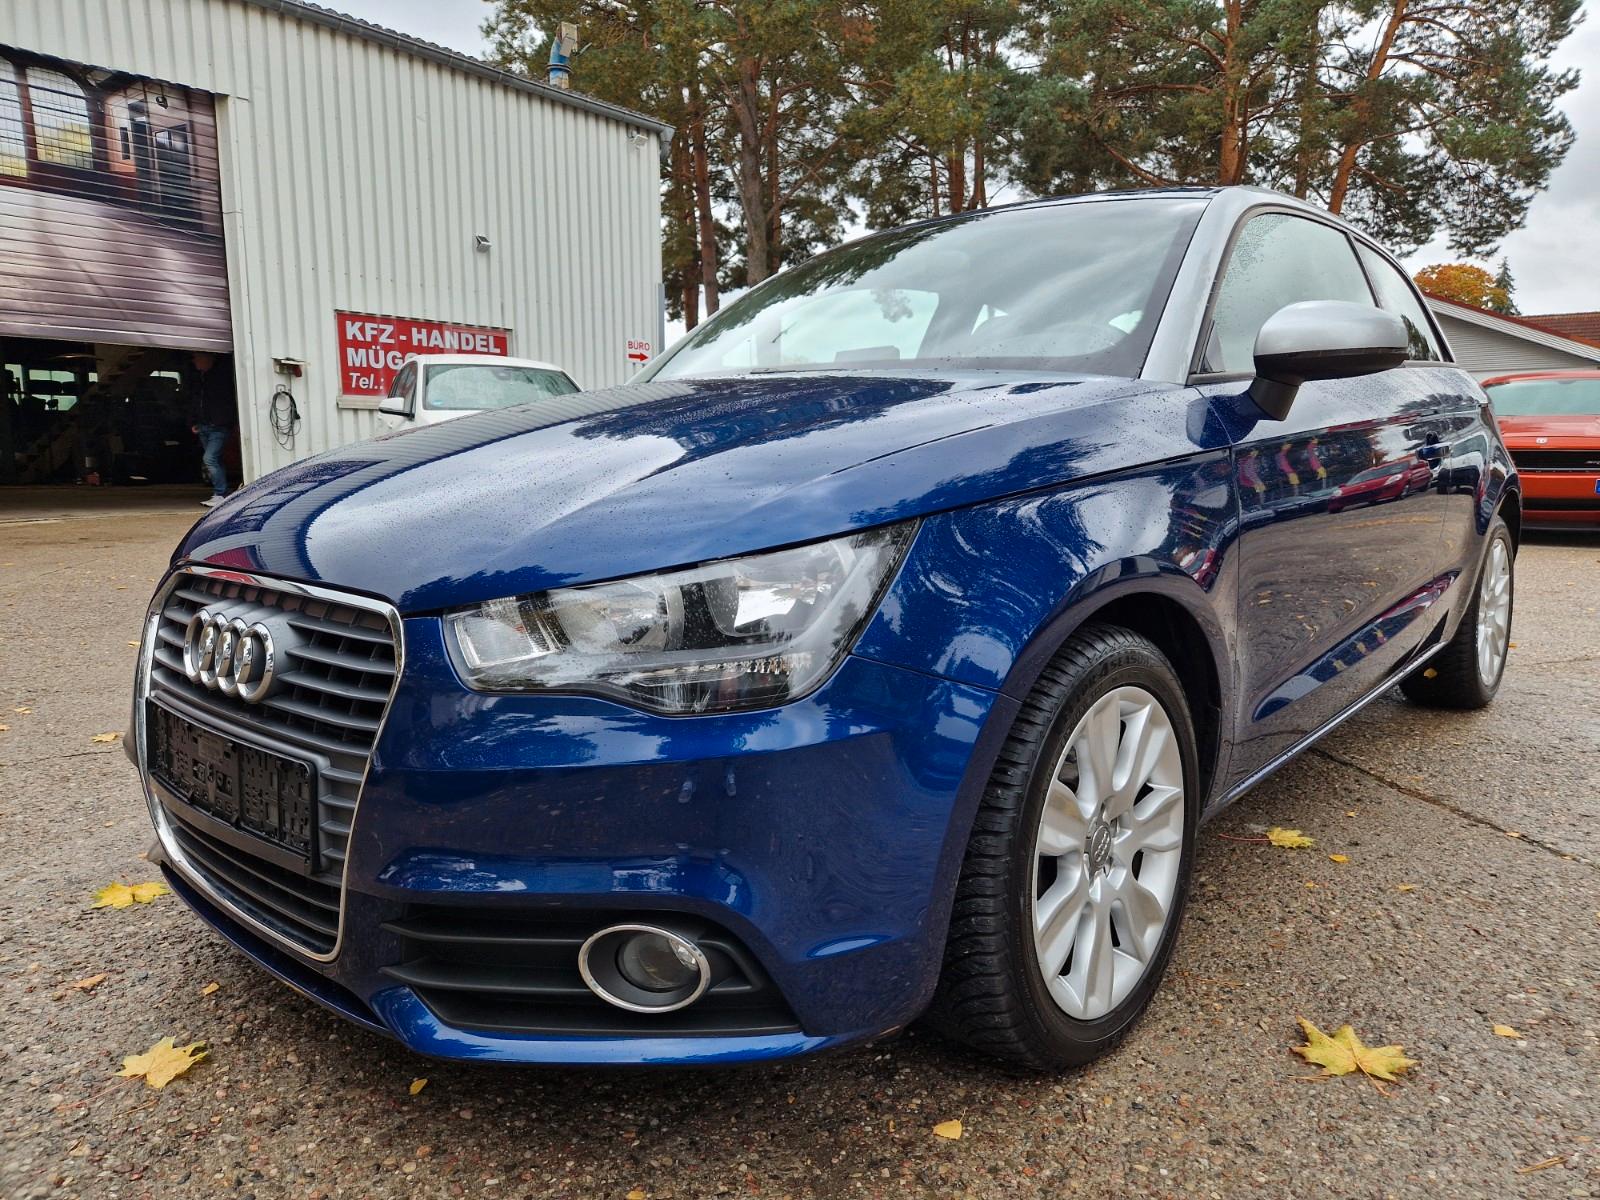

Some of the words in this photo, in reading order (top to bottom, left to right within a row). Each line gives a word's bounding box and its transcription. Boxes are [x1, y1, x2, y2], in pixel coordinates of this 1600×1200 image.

[345, 320, 395, 344] KFZ
[411, 327, 501, 354] HANDEL
[627, 339, 650, 352] BÜRO
[349, 372, 385, 390] Tel.:
